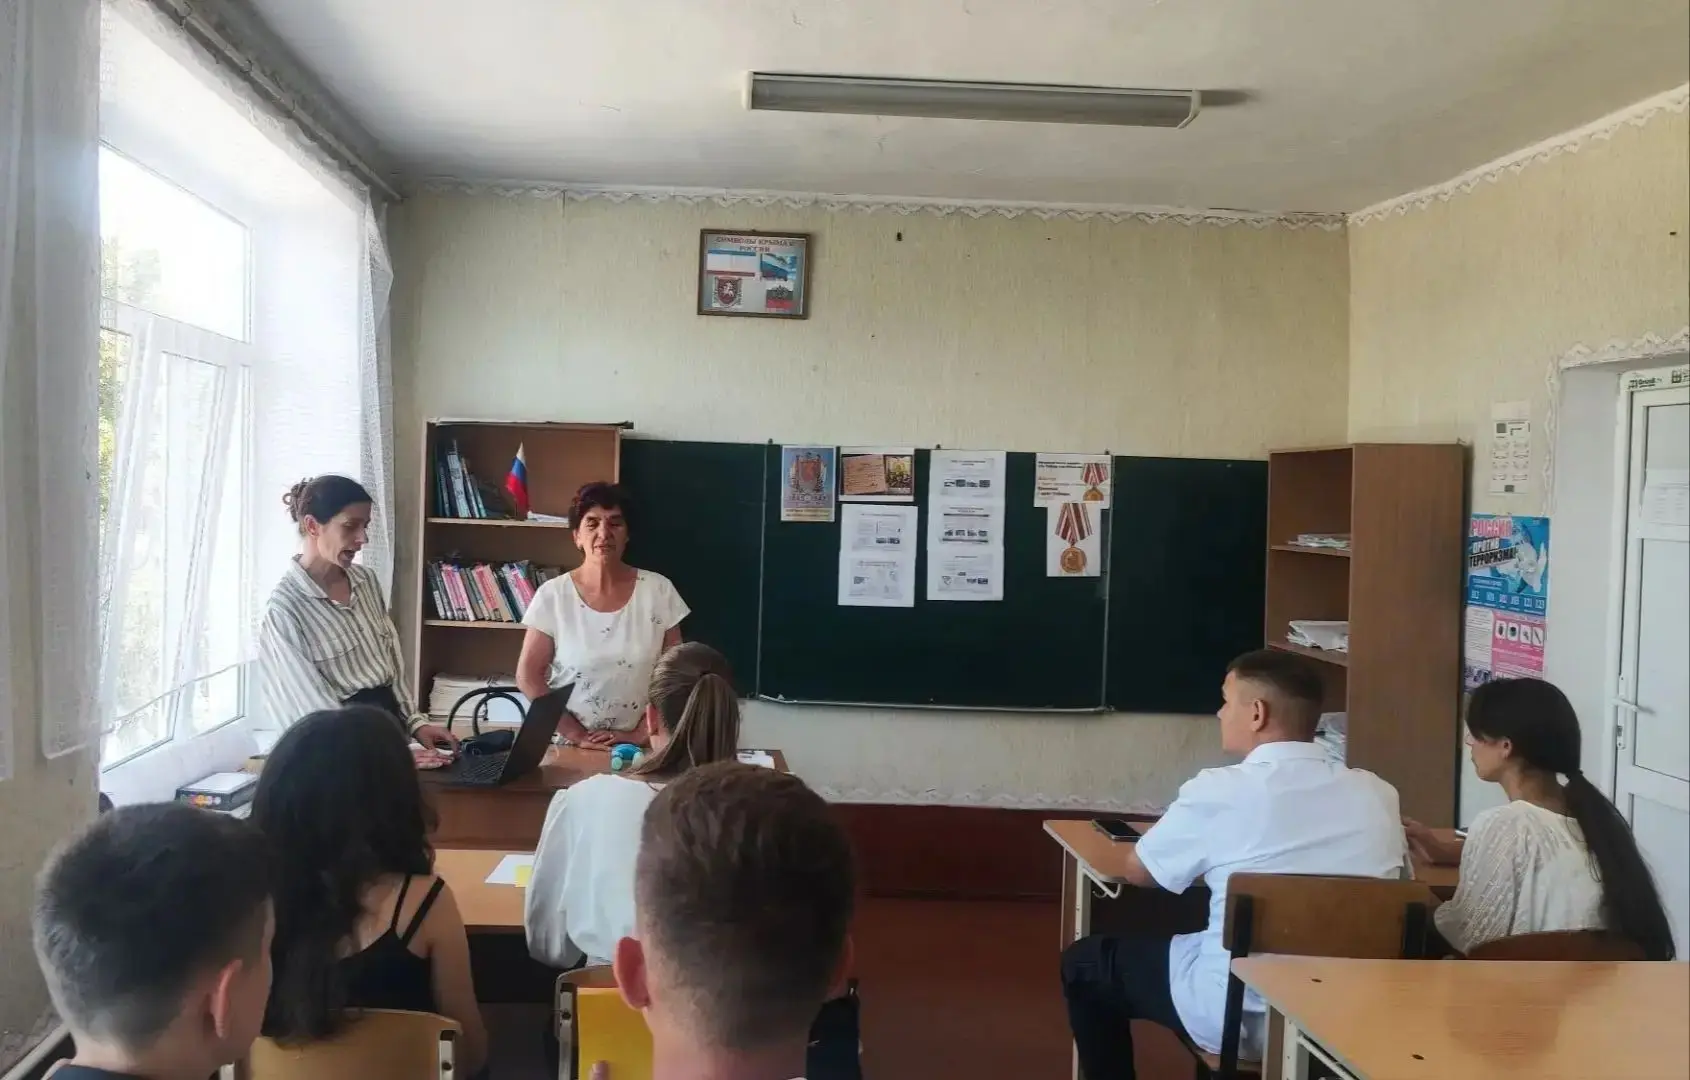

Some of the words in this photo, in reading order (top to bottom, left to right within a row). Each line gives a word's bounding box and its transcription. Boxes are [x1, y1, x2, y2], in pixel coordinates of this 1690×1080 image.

[715, 236, 756, 244] СИМВОЛЫ
[758, 238, 788, 246] КРЫМА
[1471, 518, 1512, 536] РОССИЯ
[1472, 538, 1500, 553] ПРОТИВ
